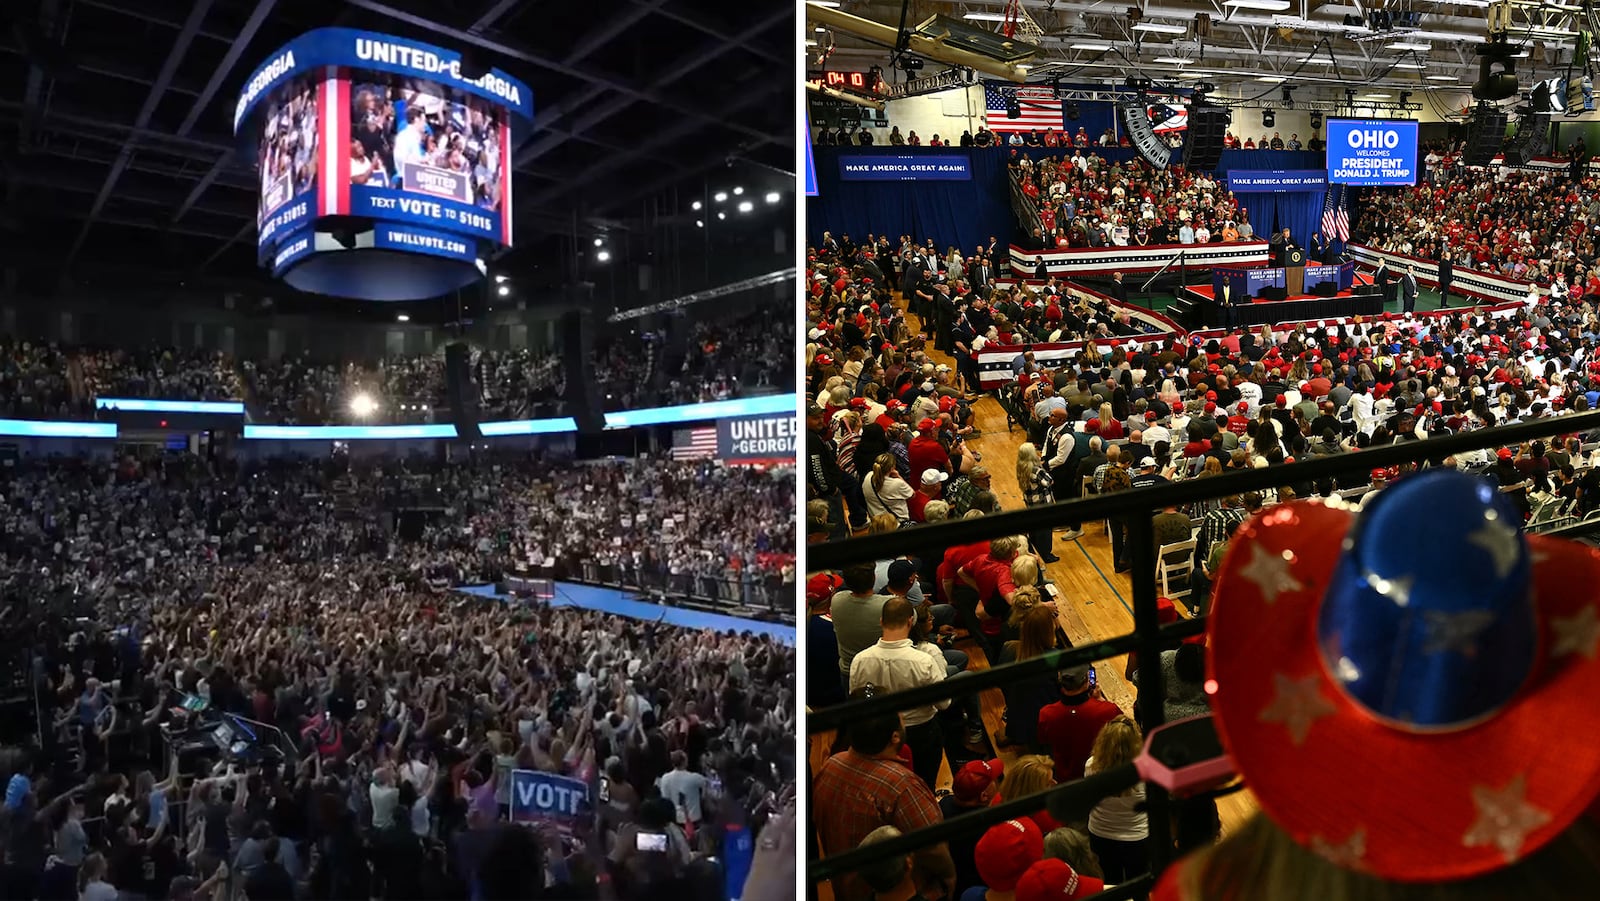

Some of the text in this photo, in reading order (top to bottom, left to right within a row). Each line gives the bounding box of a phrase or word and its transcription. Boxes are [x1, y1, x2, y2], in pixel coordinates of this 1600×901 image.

[355, 38, 439, 73] UNITED
[450, 59, 521, 106] GRGIA
[1347, 129, 1399, 149] OHIO
[1334, 169, 1410, 178] DONALD J. TRUMP
[1342, 158, 1403, 169] PRESIDENT
[370, 196, 492, 231] TEXT VOTE TO 51015
